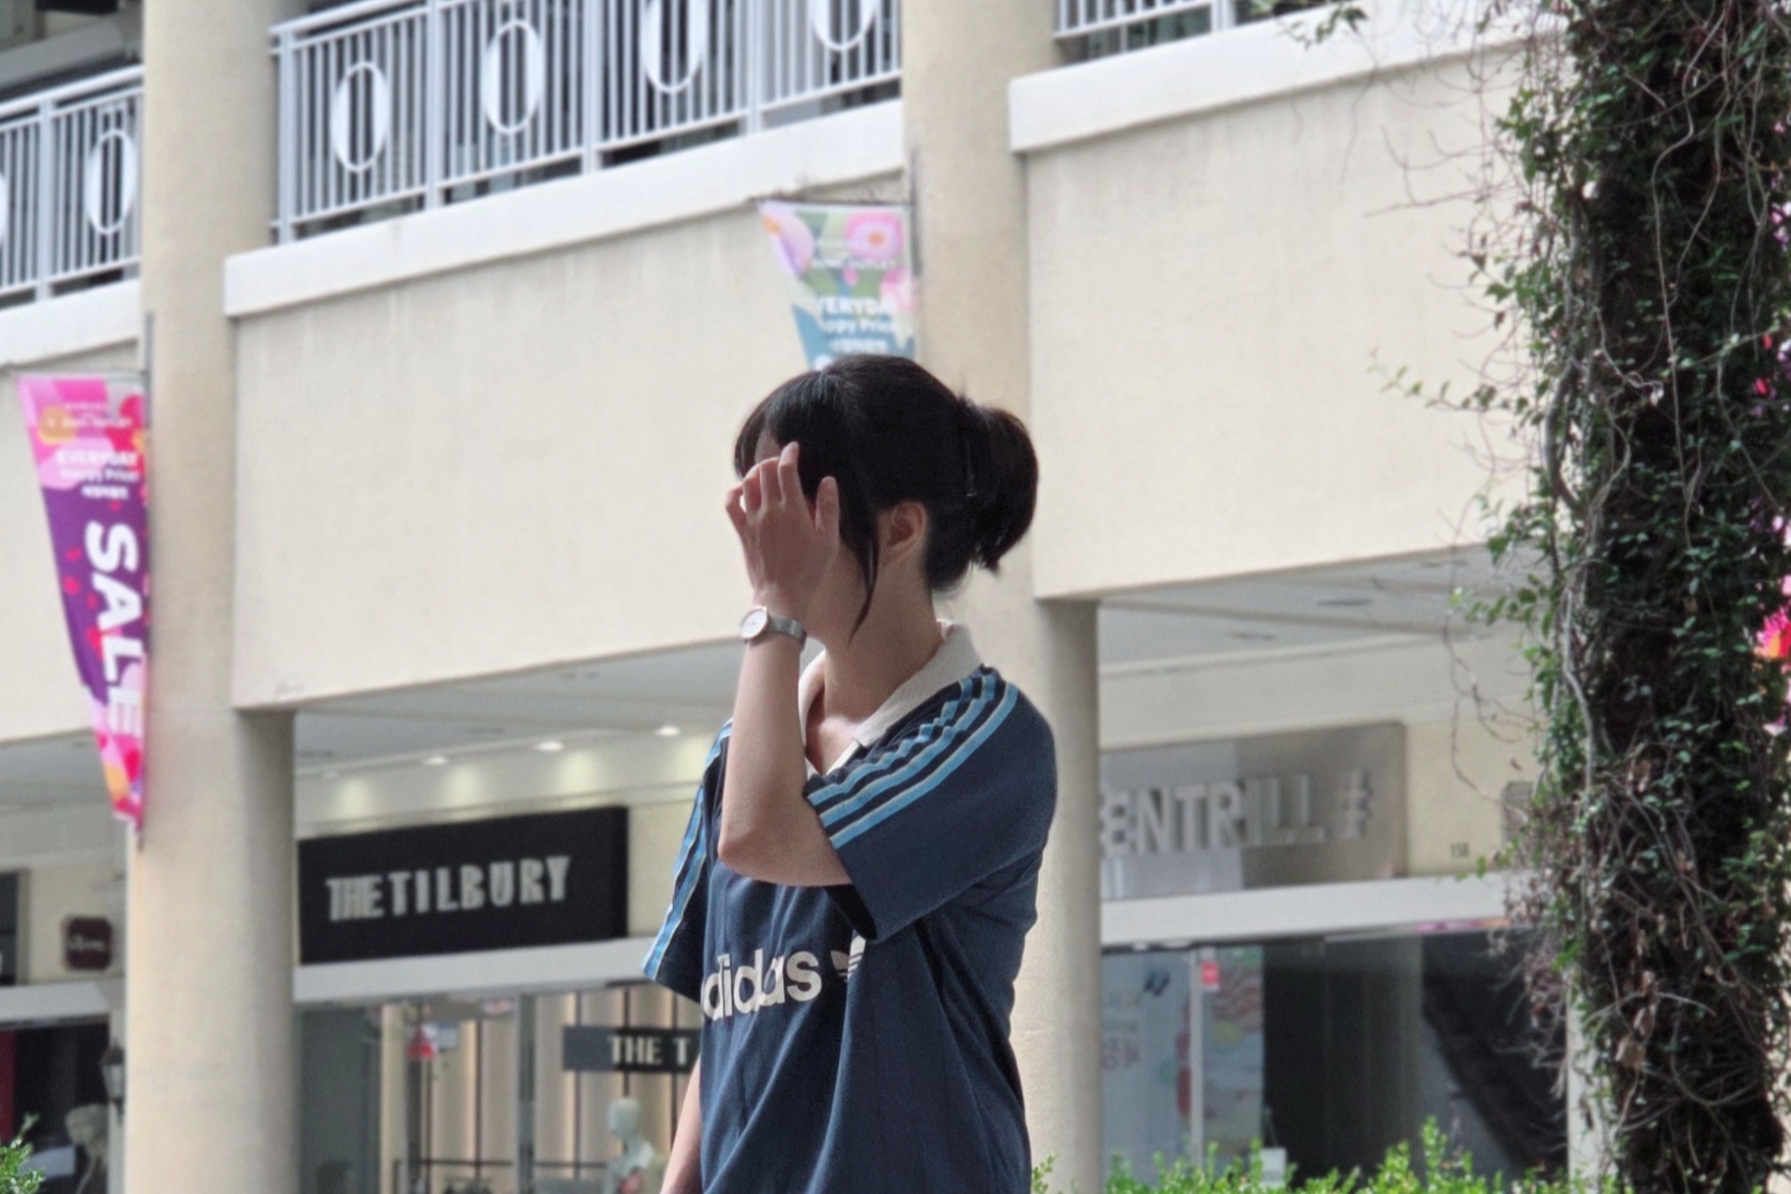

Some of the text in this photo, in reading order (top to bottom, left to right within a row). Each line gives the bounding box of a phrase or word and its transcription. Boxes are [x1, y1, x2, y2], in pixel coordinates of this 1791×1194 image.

[85, 520, 143, 737] SALE
[326, 855, 570, 921] THE TILBURY
[608, 1035, 662, 1065] THE
